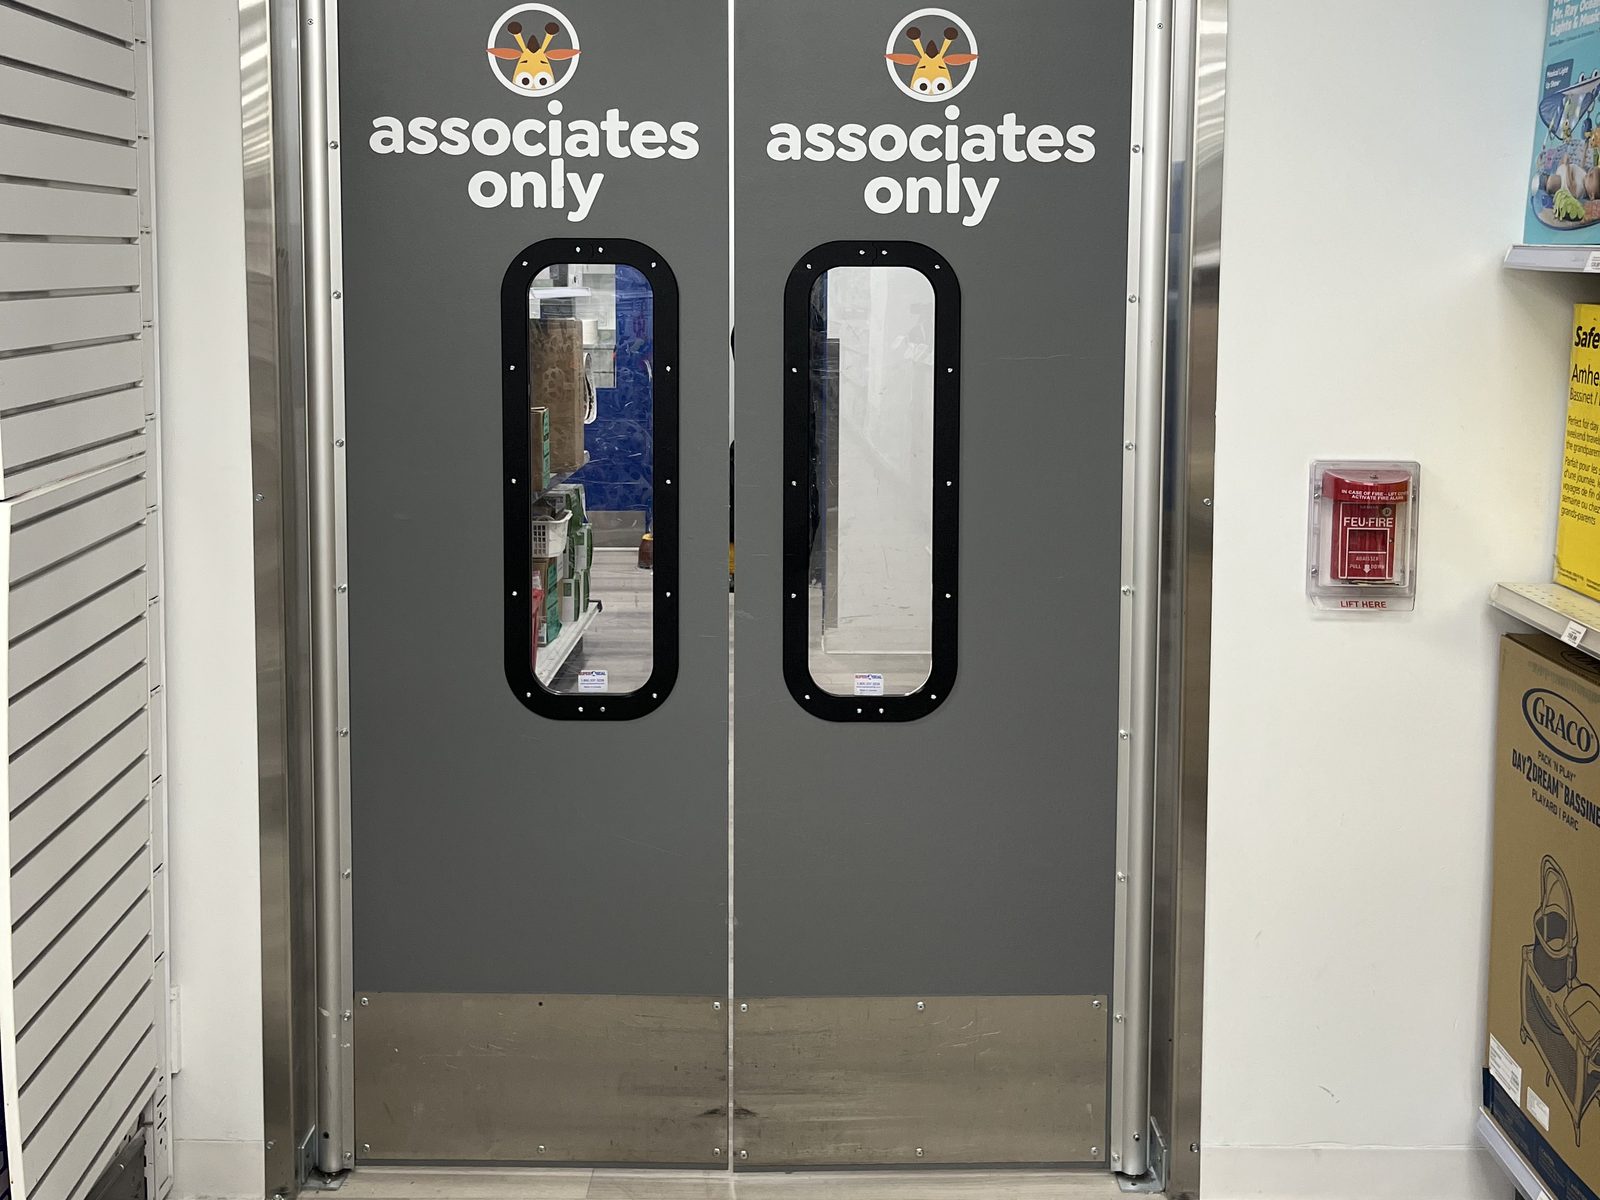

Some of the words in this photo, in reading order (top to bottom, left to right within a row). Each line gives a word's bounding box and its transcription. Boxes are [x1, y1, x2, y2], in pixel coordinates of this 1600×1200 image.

[1551, 20, 1571, 37] Lights
[369, 100, 700, 160] associates
[766, 105, 1096, 163] associates
[467, 158, 605, 222] only
[864, 162, 1000, 227] only
[1570, 387, 1593, 405] Bassinet
[1567, 415, 1581, 428] Perfect
[1582, 418, 1590, 429] for
[1590, 421, 1599, 433] day
[1567, 430, 1585, 442] weekend
[1565, 456, 1578, 469] Parfait
[1578, 462, 1591, 472] pour
[1581, 488, 1588, 497] de
[1581, 501, 1588, 510] ou
[1561, 507, 1596, 525] grands-parents
[1340, 600, 1359, 608] LIFT
[1361, 600, 1387, 608] HERE
[1532, 697, 1592, 752] GRACO
[1537, 750, 1552, 768] PACK
[1531, 788, 1558, 816] PLAYARD
[1562, 811, 1579, 831] PARC
